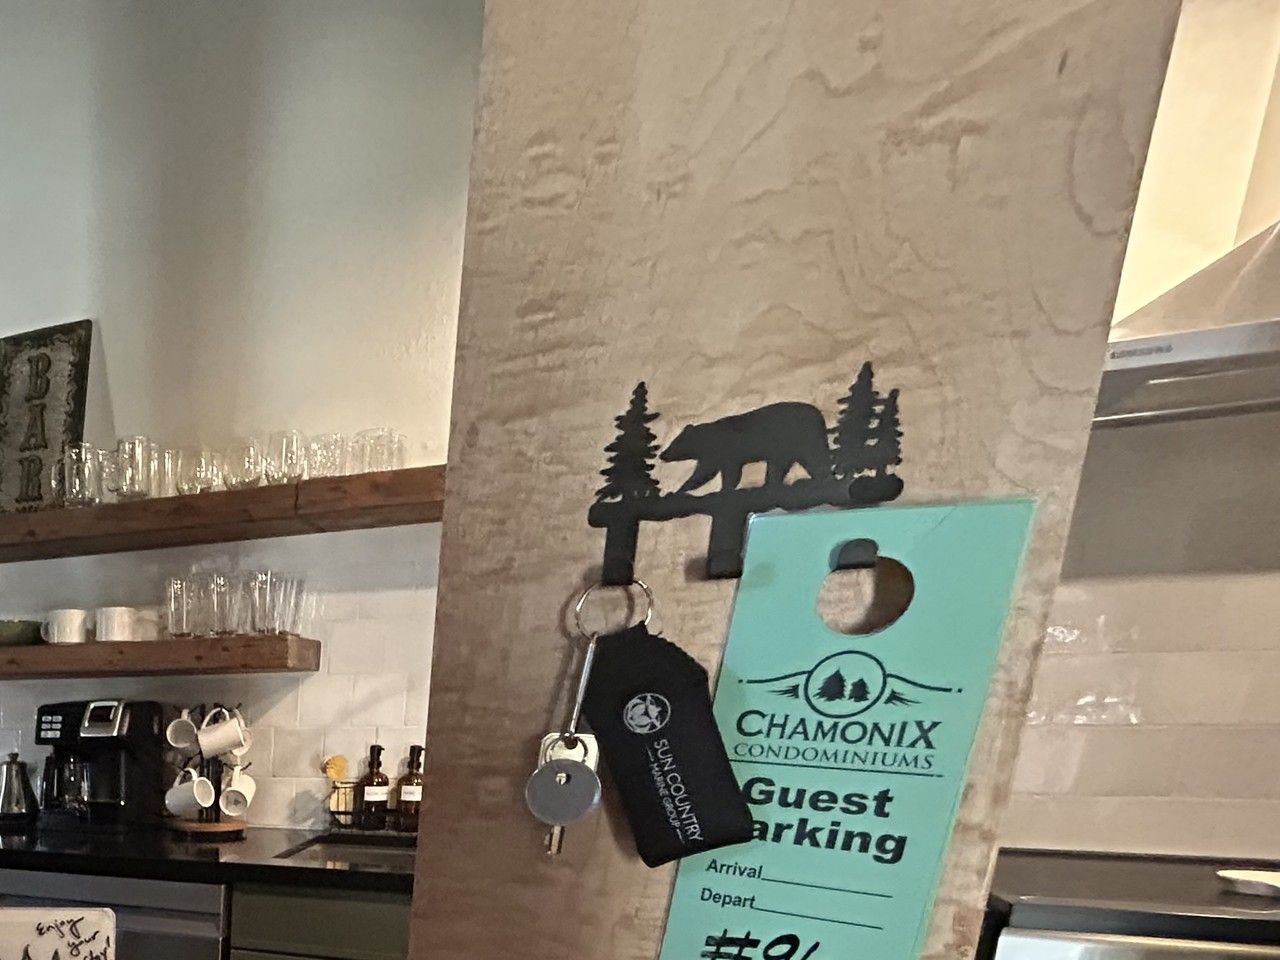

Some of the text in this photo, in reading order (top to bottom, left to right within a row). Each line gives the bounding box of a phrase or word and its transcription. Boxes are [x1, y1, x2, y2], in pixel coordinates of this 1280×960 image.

[736, 709, 942, 750] CHAMONIX
[733, 742, 935, 770] CONDOMINIUMS
[650, 763, 681, 828] MARINE GROUP
[654, 738, 704, 841] SUN COUNTRY
[741, 776, 894, 819] Guest
[751, 817, 908, 865] arking
[705, 858, 763, 880] Arrival
[700, 887, 756, 909] Depart
[36, 916, 85, 939] Enjoy
[67, 930, 99, 957] your
